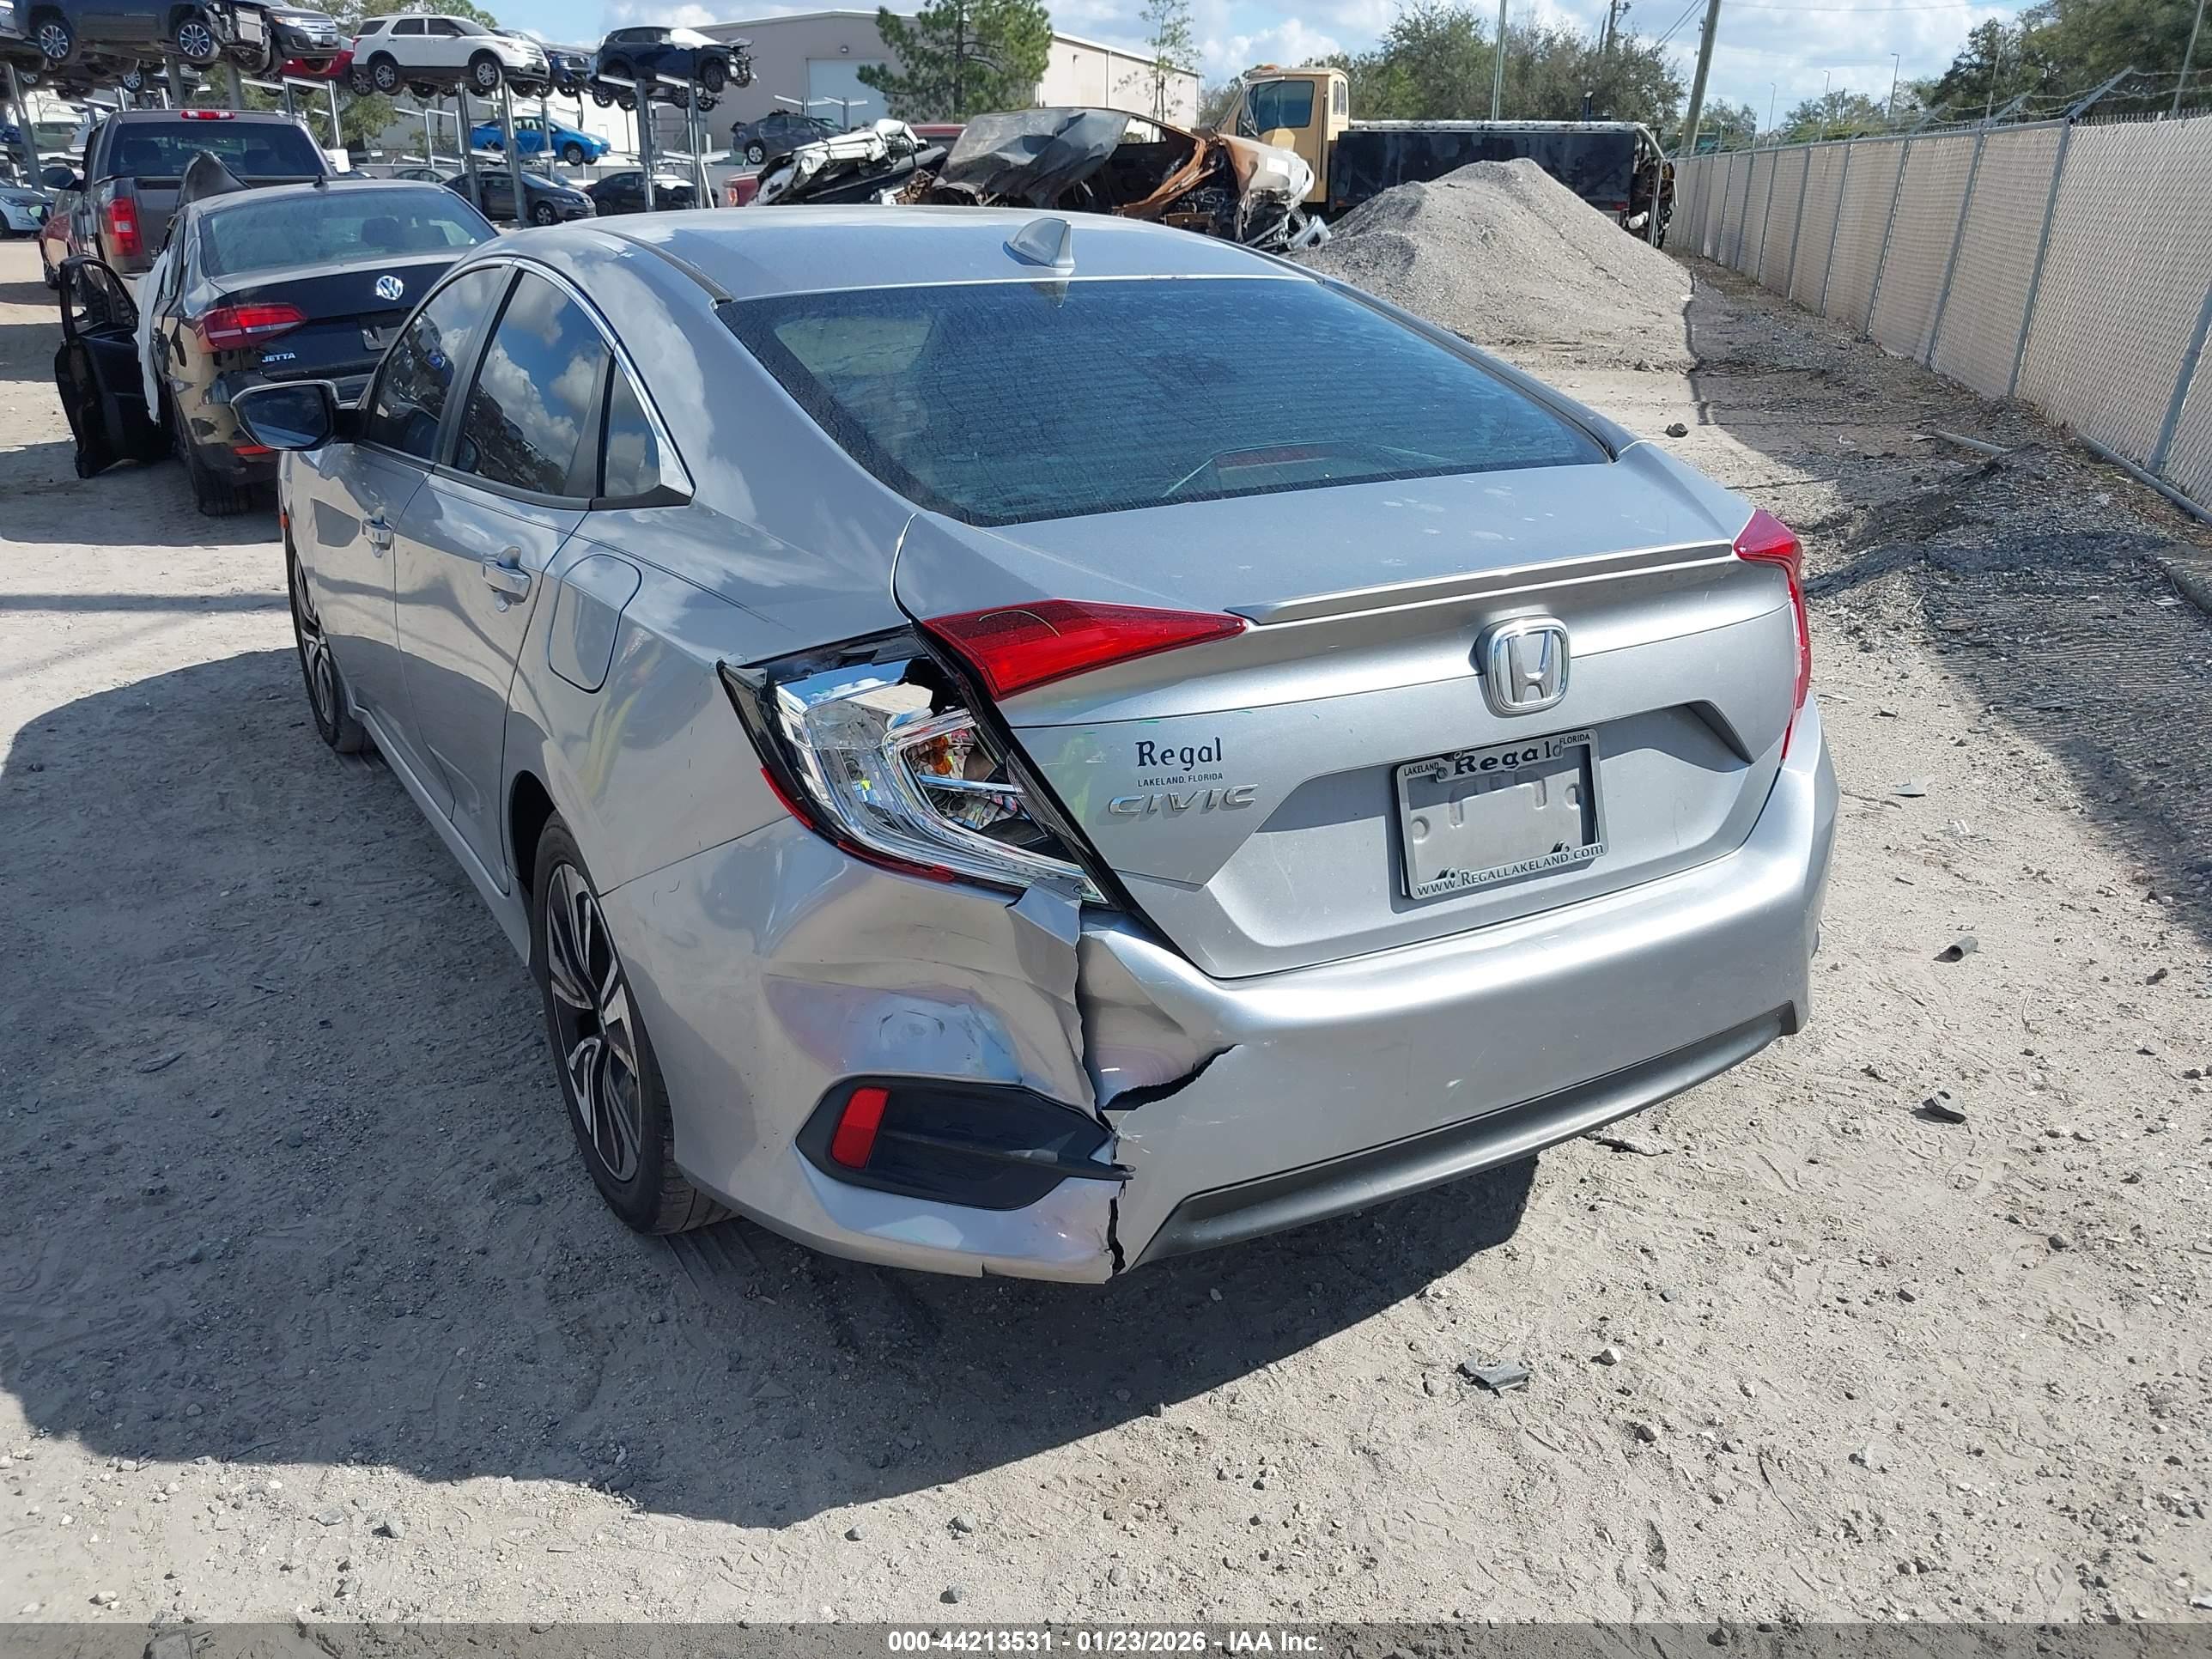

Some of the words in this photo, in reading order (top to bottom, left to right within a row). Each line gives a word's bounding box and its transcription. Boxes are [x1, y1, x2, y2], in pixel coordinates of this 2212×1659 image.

[262, 352, 295, 362] JETTA
[1559, 732, 1590, 745] FLORIDA
[1135, 737, 1223, 771] Regal
[1454, 741, 1551, 775] Regal
[1403, 762, 1439, 776] LAKELAND
[1188, 772, 1224, 783] FLORIDA
[1109, 783, 1259, 816] CIVIC
